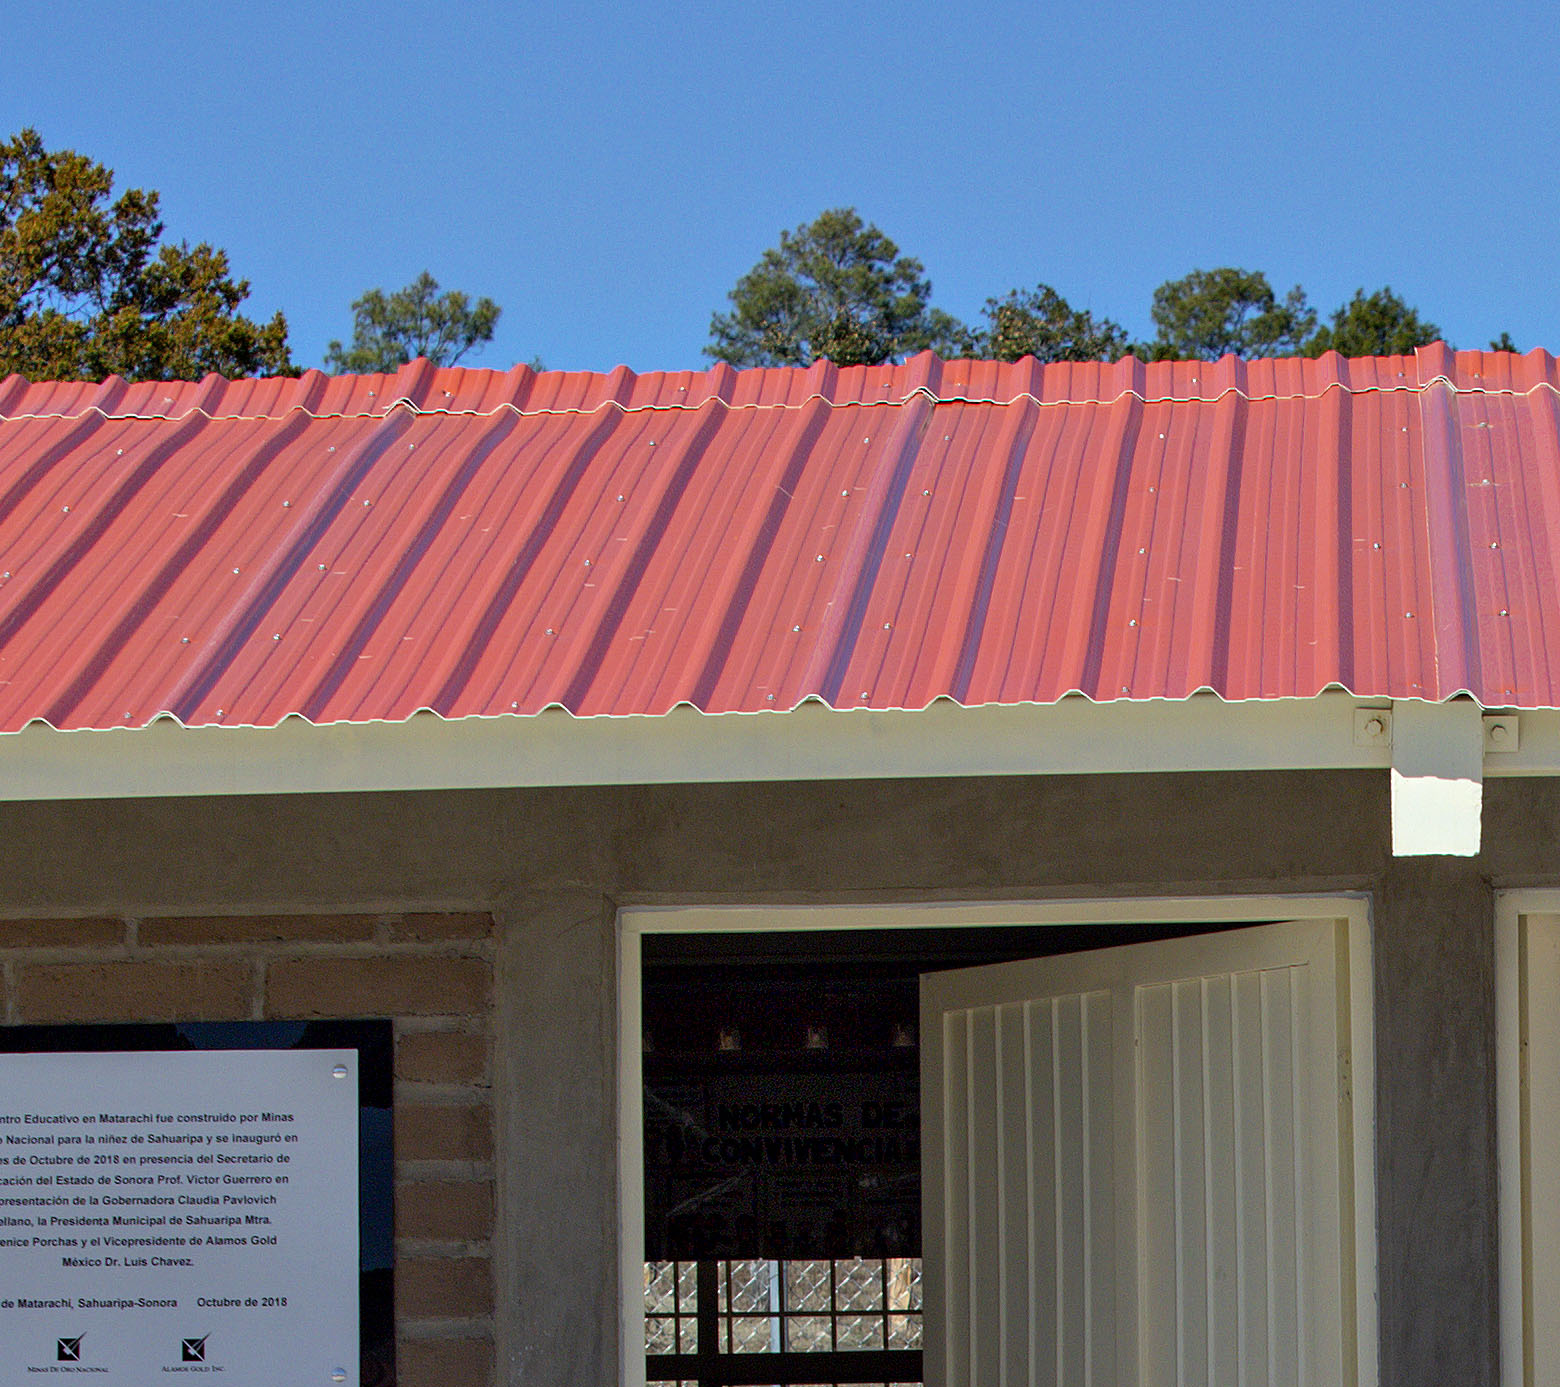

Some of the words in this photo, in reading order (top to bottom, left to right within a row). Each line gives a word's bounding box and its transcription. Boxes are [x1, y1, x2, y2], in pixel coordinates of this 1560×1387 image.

[24, 1113, 80, 1123] Educativo
[82, 1115, 96, 1123] en
[155, 1114, 174, 1123] fue
[240, 1114, 258, 1124] por
[262, 1112, 294, 1122] Minas
[6, 1135, 54, 1144] Nacional
[56, 1136, 82, 1146] para
[85, 1135, 94, 1144] la
[98, 1134, 127, 1144] niñez
[130, 1134, 144, 1143] de
[147, 1134, 203, 1145] Sahuaripa
[216, 1135, 228, 1143] se
[232, 1133, 281, 1145] inauguró
[284, 1134, 298, 1142] en
[11, 1156, 26, 1165] de
[30, 1155, 73, 1165] Octubre
[76, 1155, 90, 1164] de
[94, 1155, 119, 1164] 2018
[122, 1156, 136, 1164] en
[140, 1155, 193, 1166] presencia
[196, 1154, 213, 1164] del
[216, 1154, 273, 1163] Secretario
[276, 1153, 290, 1163] de
[36, 1176, 52, 1185] del
[56, 1175, 94, 1185] Estado
[96, 1175, 111, 1184] de
[114, 1175, 154, 1184] Sonora
[222, 1174, 272, 1184] Guerrero
[274, 1176, 288, 1184] en
[72, 1196, 86, 1206] de
[88, 1196, 98, 1206] la
[102, 1195, 174, 1205] Gobernadora
[176, 1195, 219, 1205] Claudia
[221, 1195, 276, 1204] Pavlovich
[38, 1217, 47, 1226] la
[50, 1216, 109, 1226] Presidenta
[112, 1216, 166, 1227] Municipal
[168, 1216, 182, 1225] de
[186, 1215, 242, 1227] Sahuaripa
[32, 1237, 78, 1246] Porchas
[90, 1237, 100, 1246] el
[102, 1236, 186, 1248] Vicepresidente
[189, 1236, 202, 1245] de
[206, 1236, 247, 1245] Alamos
[250, 1235, 277, 1245] Gold
[62, 1257, 102, 1267] México
[124, 1257, 148, 1266] Luis
[0, 1299, 14, 1308] de
[78, 1298, 178, 1310] Sahuaripa-Sonora
[196, 1297, 241, 1307] Octubre
[244, 1297, 258, 1307] de
[262, 1297, 287, 1306] 2018
